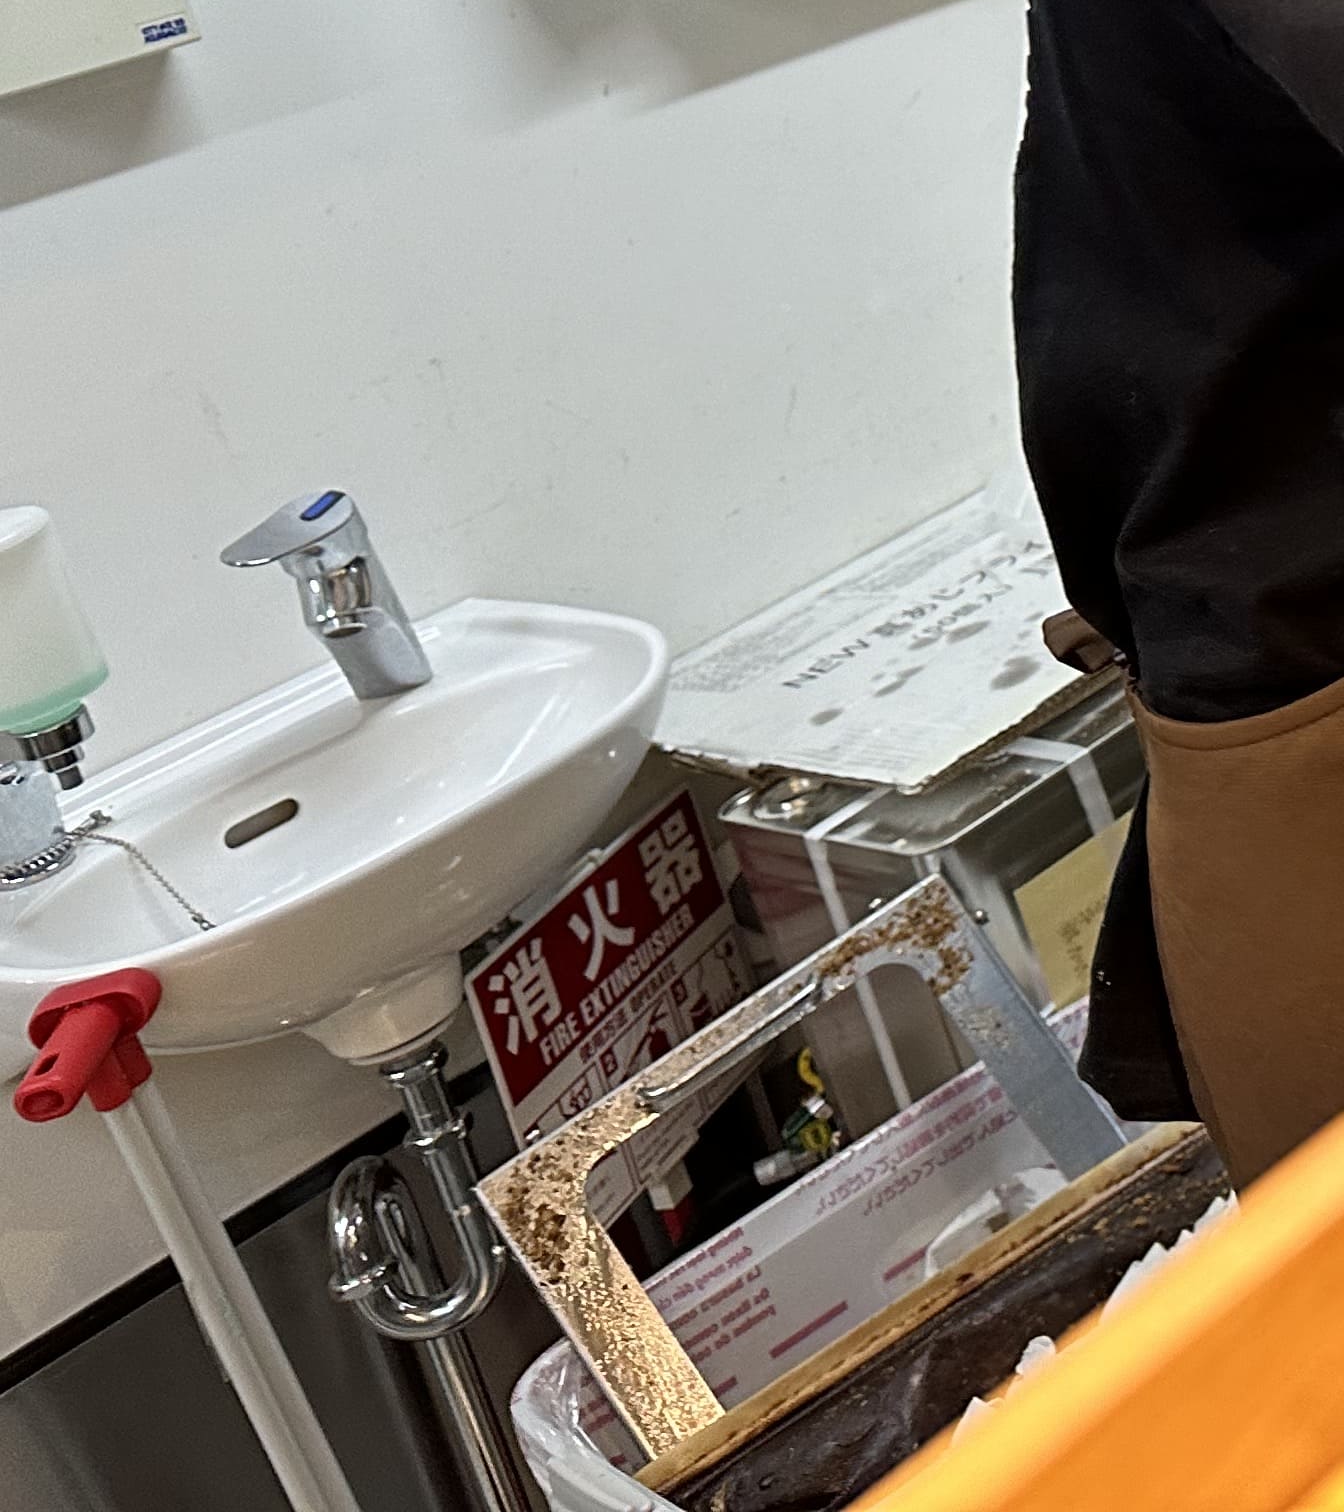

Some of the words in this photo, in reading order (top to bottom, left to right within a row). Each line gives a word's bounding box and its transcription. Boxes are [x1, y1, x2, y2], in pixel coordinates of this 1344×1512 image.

[781, 638, 872, 690] NEW
[487, 808, 704, 1056] 消火器
[539, 1012, 580, 1066] FIRE
[578, 904, 697, 1029] EXTINGUISHER
